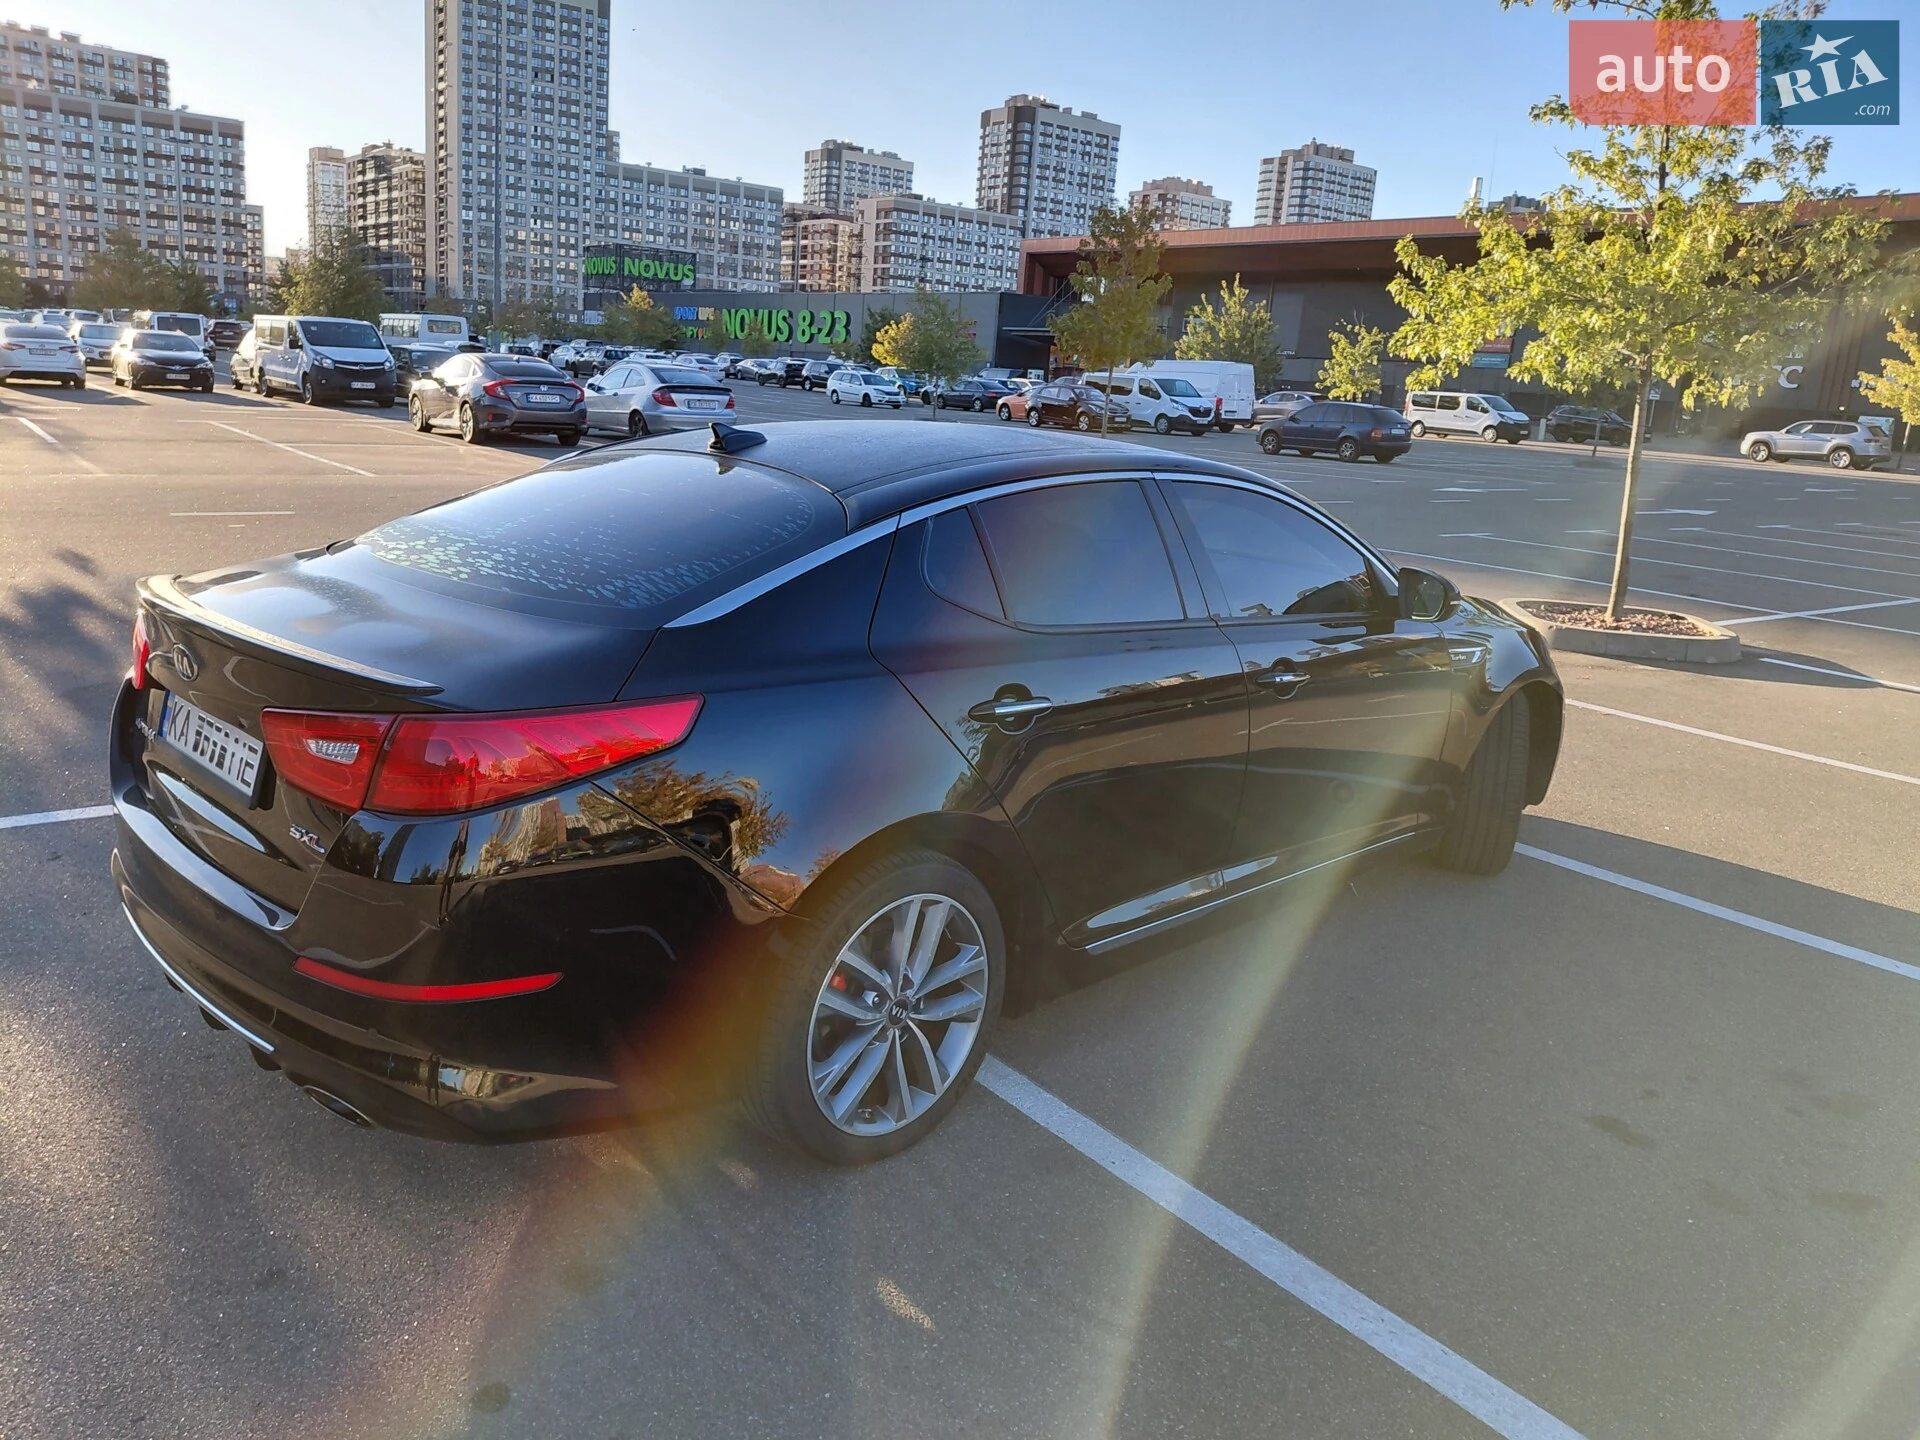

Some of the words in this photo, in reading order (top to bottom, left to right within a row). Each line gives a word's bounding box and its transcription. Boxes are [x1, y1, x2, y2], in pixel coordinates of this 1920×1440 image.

[584, 256, 616, 275] NOVUS
[624, 256, 695, 281] NOVUS
[796, 309, 850, 344] 8-23
[168, 699, 191, 748] KA
[892, 1004, 908, 1020] KIA
